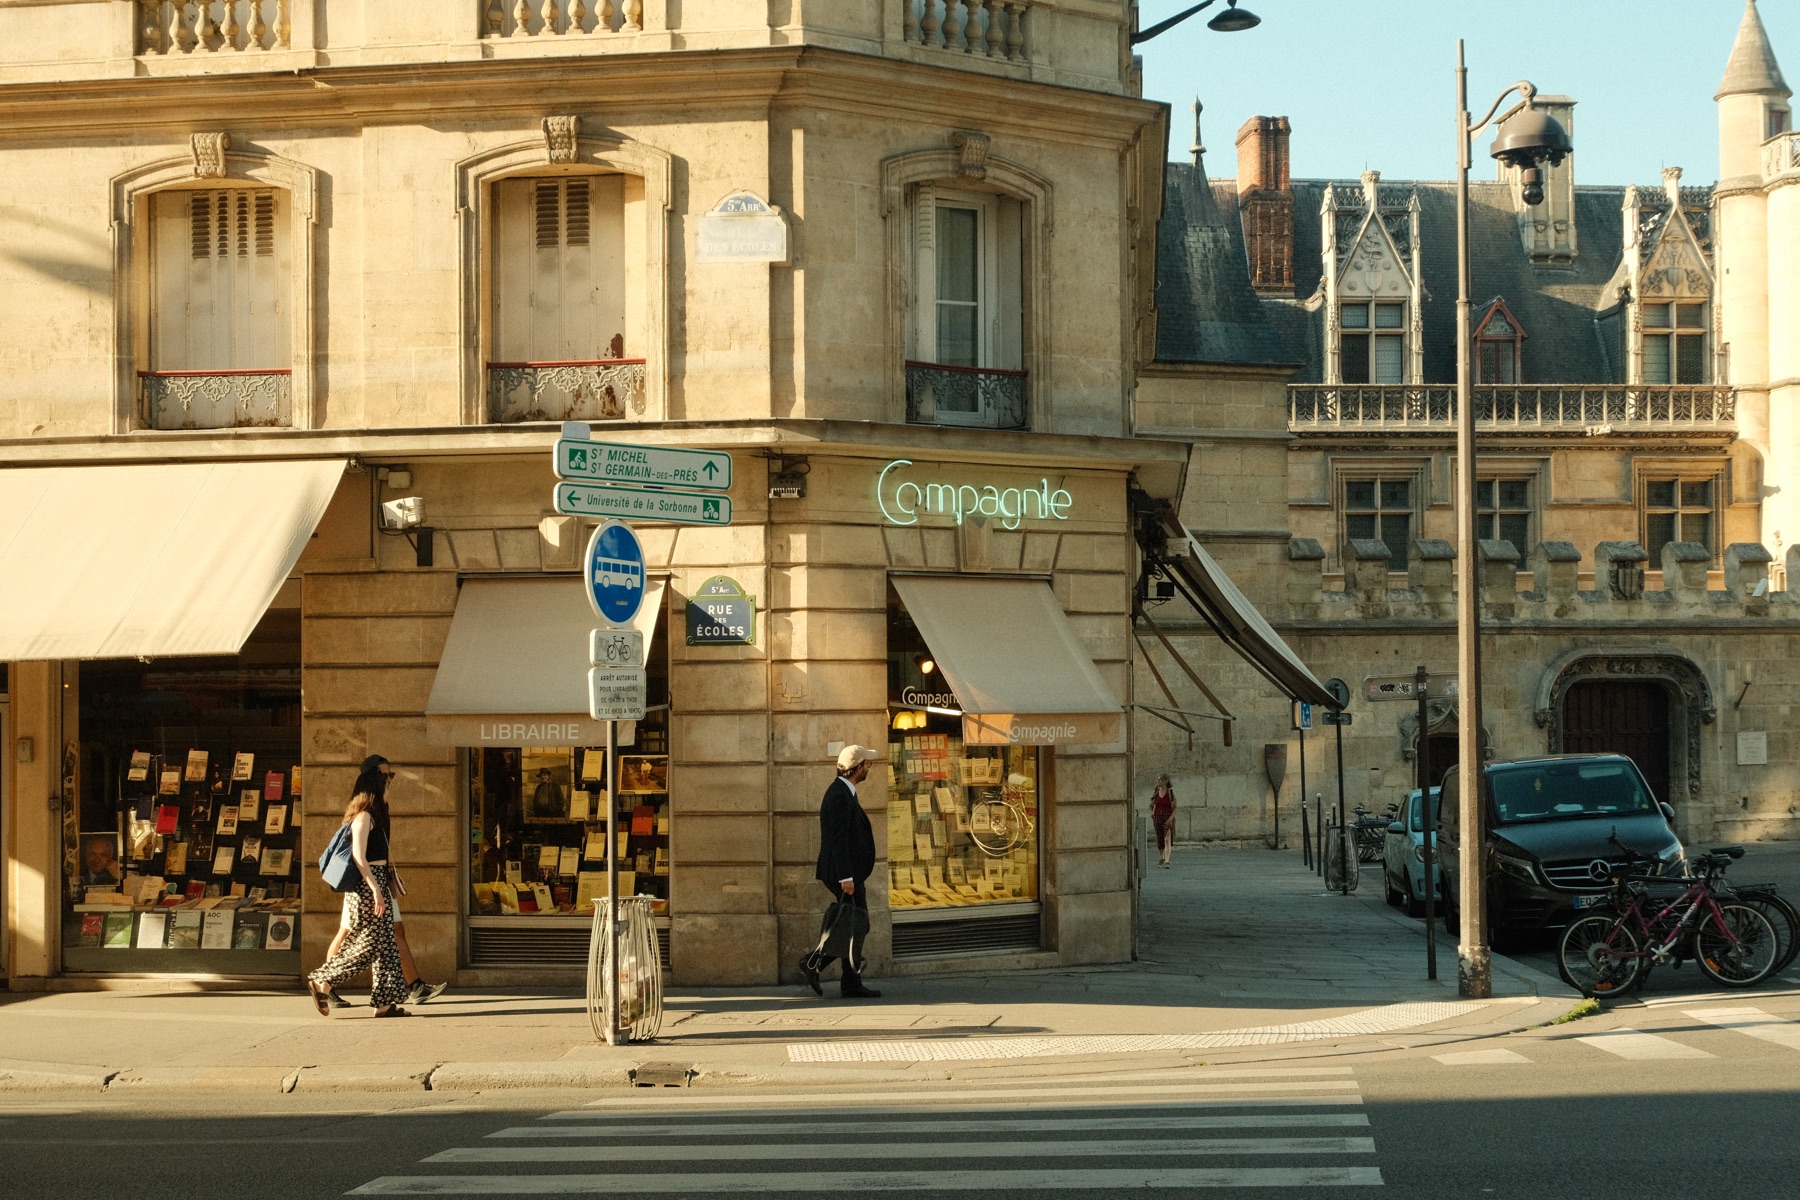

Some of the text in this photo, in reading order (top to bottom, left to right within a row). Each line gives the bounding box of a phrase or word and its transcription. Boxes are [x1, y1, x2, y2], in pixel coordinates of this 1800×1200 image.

[607, 449, 648, 464] MICHEL
[605, 463, 698, 482] GERMAIN-DES-PRÉS
[877, 459, 1073, 530] Compagnie
[587, 493, 698, 514] Université de la Sorbonne
[708, 604, 733, 615] RUE
[696, 624, 744, 636] ÉCOLES
[600, 673, 615, 681] ARRÊT
[613, 685, 639, 693] LIVRAISONS
[902, 685, 960, 708] Compagn
[480, 723, 580, 740] LIBRAIRIE
[1006, 718, 1077, 743] Compagnie
